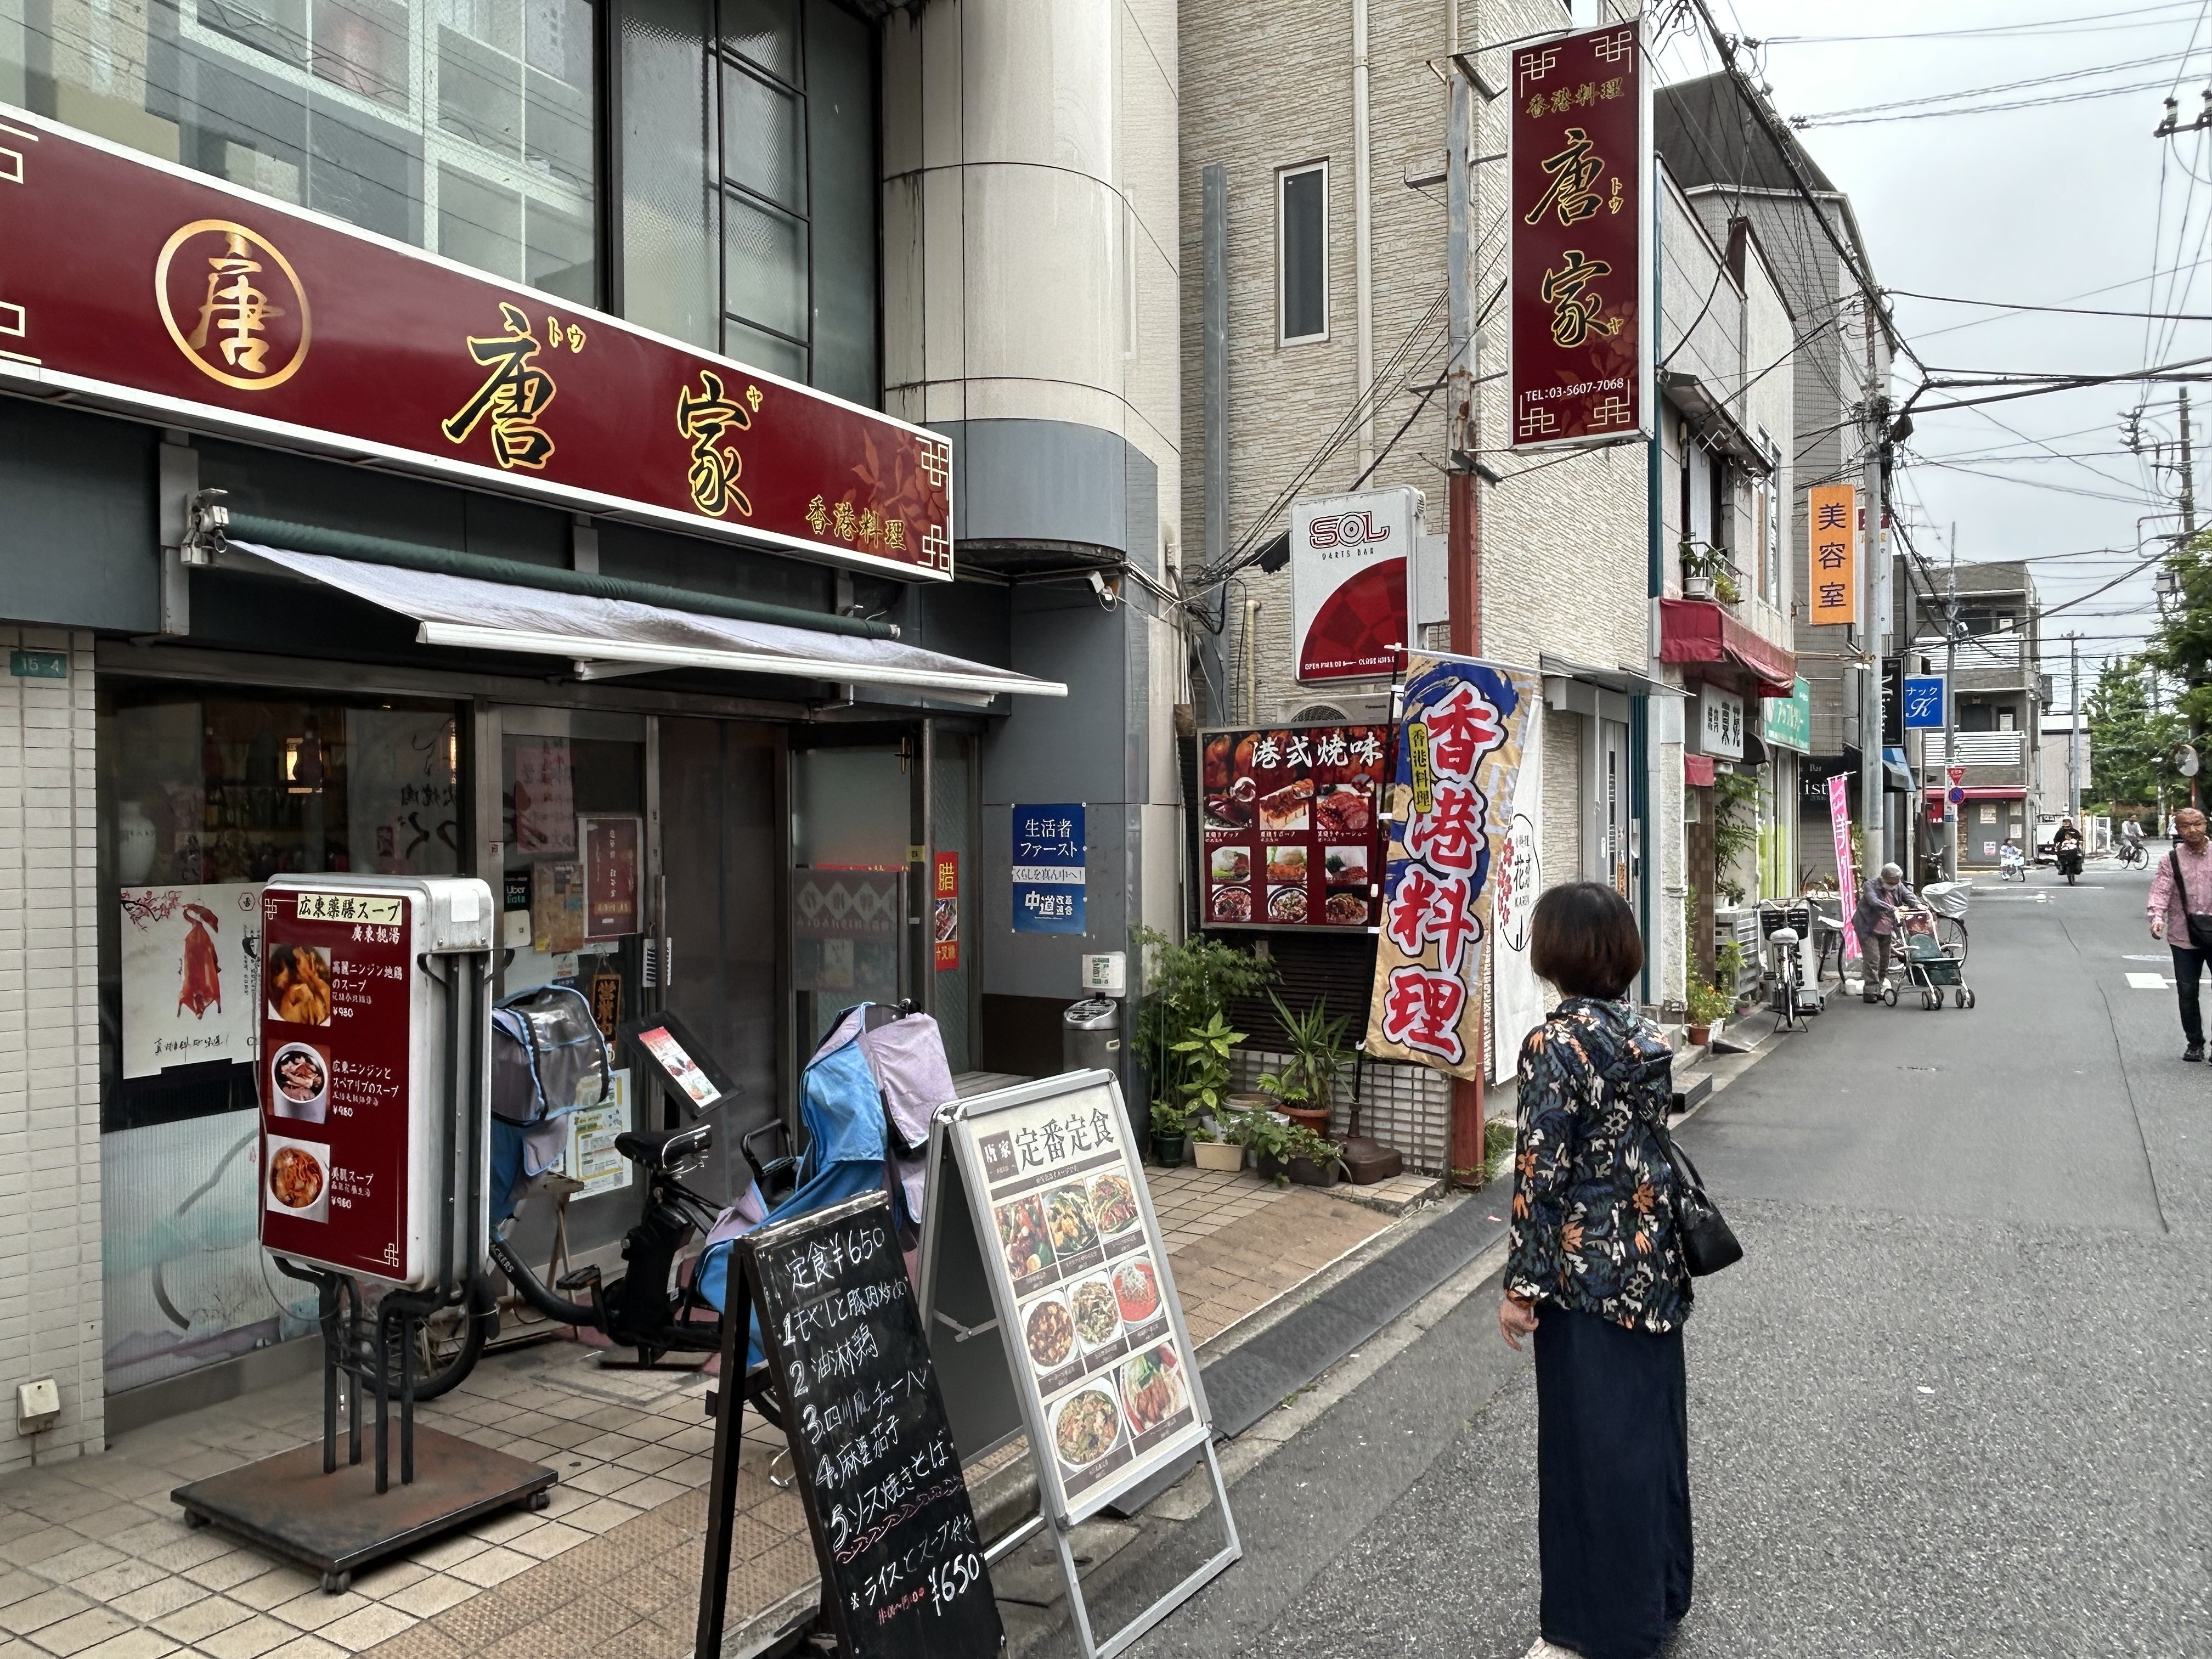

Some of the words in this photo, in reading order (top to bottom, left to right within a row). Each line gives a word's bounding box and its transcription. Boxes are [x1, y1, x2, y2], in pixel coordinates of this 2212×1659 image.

[1526, 77, 1624, 119] 香港料理
[1524, 127, 1612, 348] 唐家
[187, 232, 285, 374] 唐
[805, 494, 907, 551] 香港料理
[1309, 510, 1390, 549] SOL
[1322, 550, 1351, 560] DARTS
[1357, 548, 1374, 556] BAR
[1818, 501, 1847, 609] 美容室
[1905, 686, 1938, 696] ナック
[1905, 697, 1938, 718] K
[1025, 819, 1073, 838] 生活者
[1020, 840, 1077, 857] ファースト
[1386, 683, 1500, 1060] 香港料理
[298, 895, 400, 922] 広東薬膳スープ
[1025, 890, 1055, 915] 中道
[332, 978, 366, 992] のスープ
[1015, 1108, 1114, 1172] 定番定食
[928, 1554, 980, 1617] ¥650
